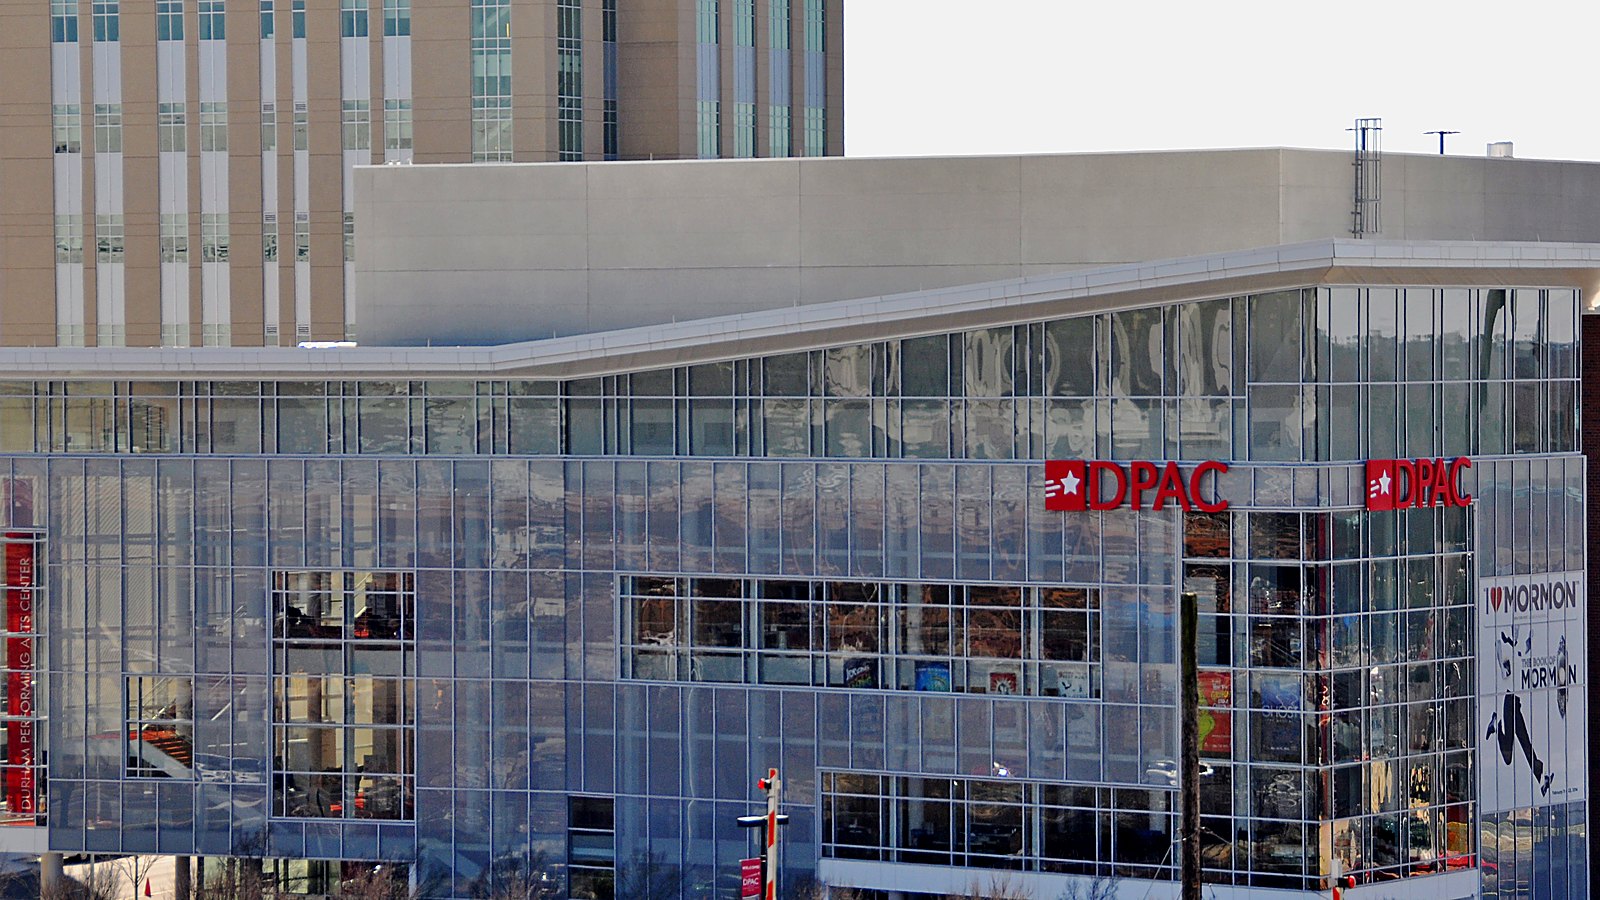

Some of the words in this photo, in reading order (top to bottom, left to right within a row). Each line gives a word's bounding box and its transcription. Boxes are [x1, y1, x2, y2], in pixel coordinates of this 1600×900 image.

[1089, 460, 1229, 513] DPAC
[1395, 456, 1472, 509] DPAC
[20, 558, 31, 611] CENTER
[1504, 581, 1576, 613] MORMON
[20, 616, 31, 648] ATS
[1262, 705, 1299, 719] GHOST
[20, 747, 32, 810] DURHAM
[743, 878, 759, 886] DPAC
